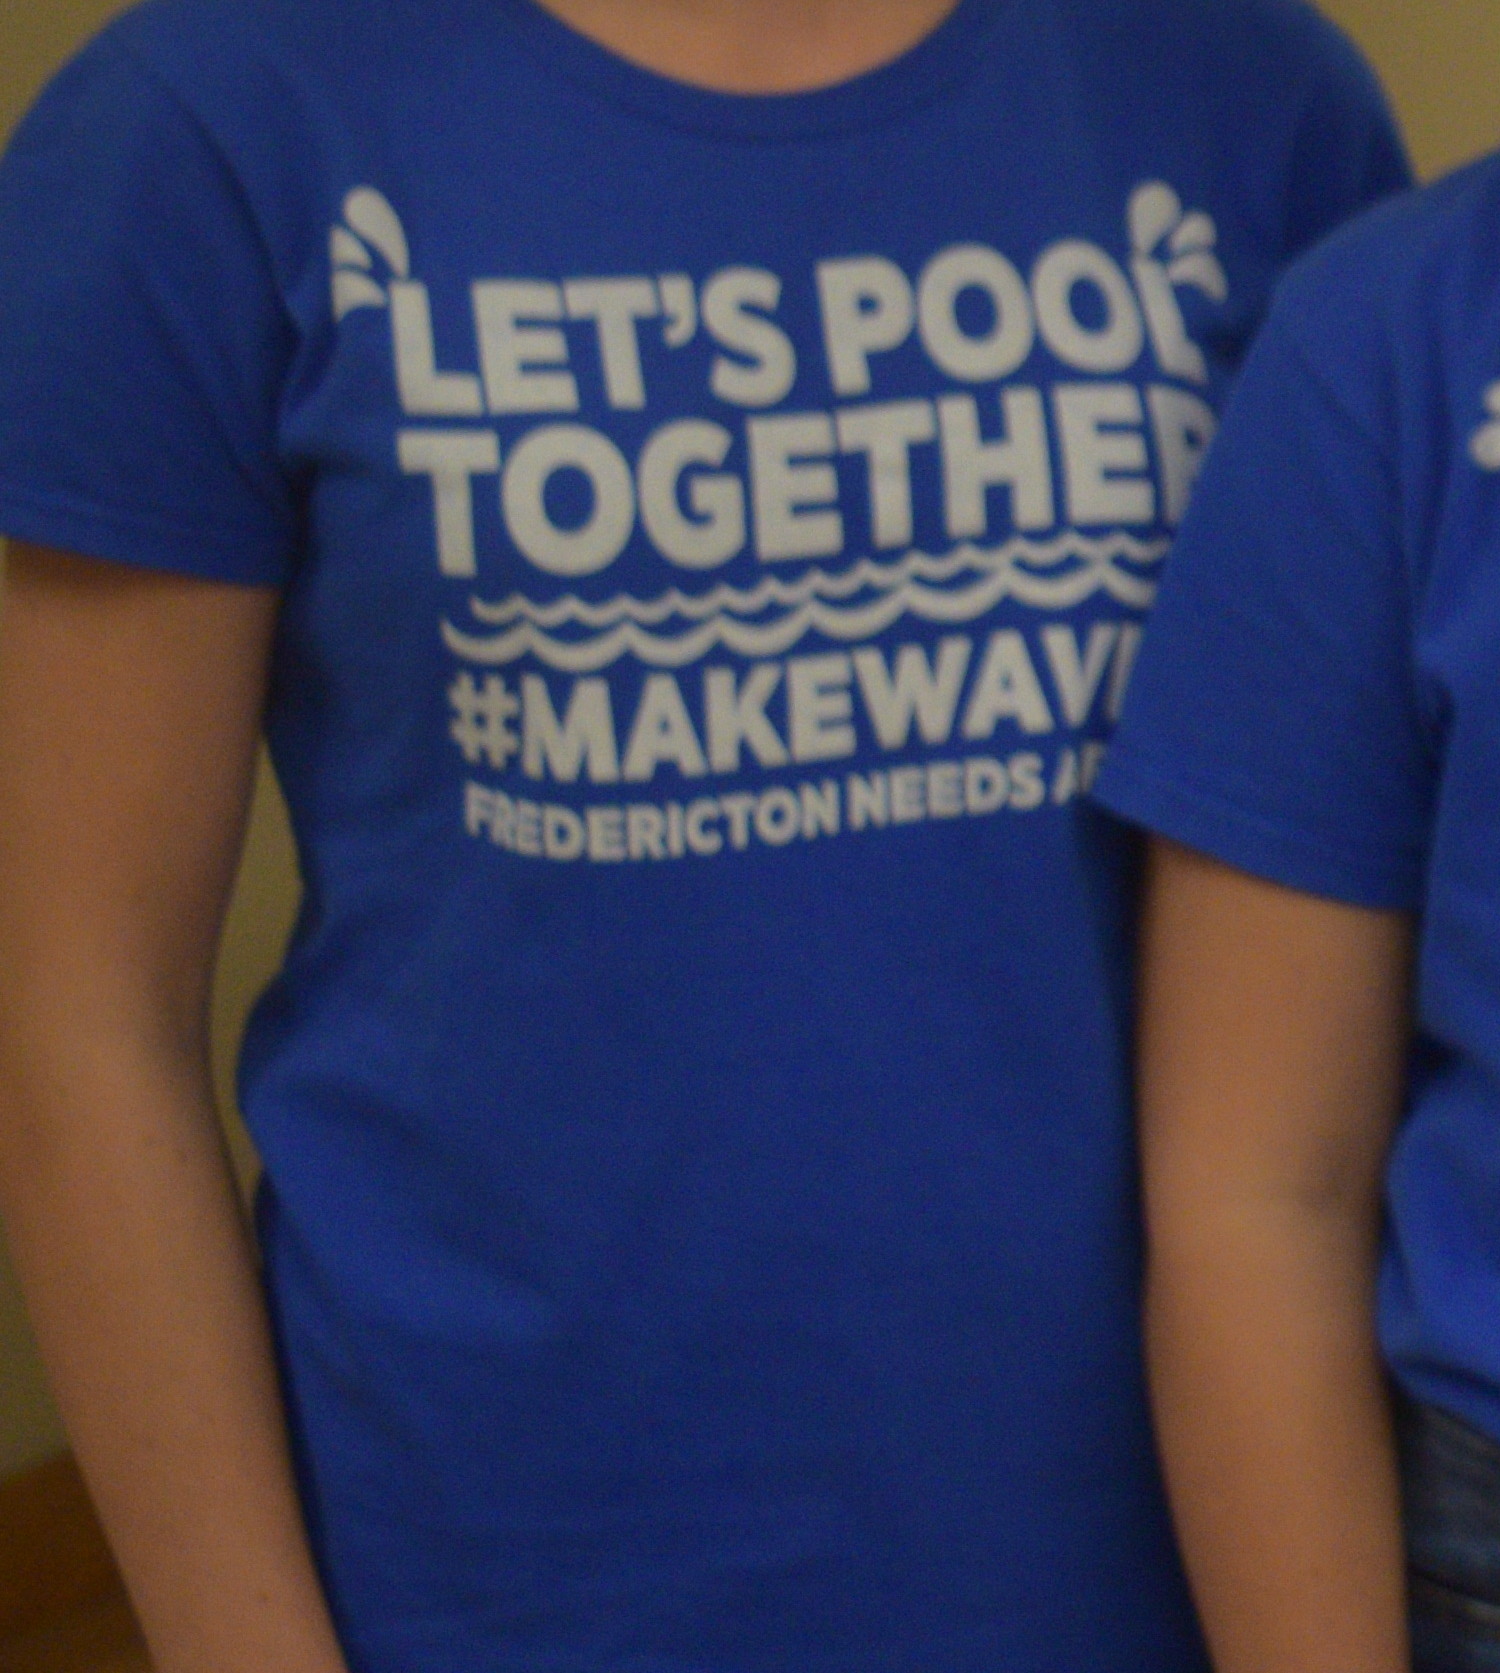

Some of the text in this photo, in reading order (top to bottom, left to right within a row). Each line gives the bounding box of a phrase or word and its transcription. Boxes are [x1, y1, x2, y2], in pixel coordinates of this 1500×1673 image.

[392, 266, 797, 416] LET’S
[464, 779, 840, 864] FREDERICTON
[847, 752, 1045, 830] NEEDS
